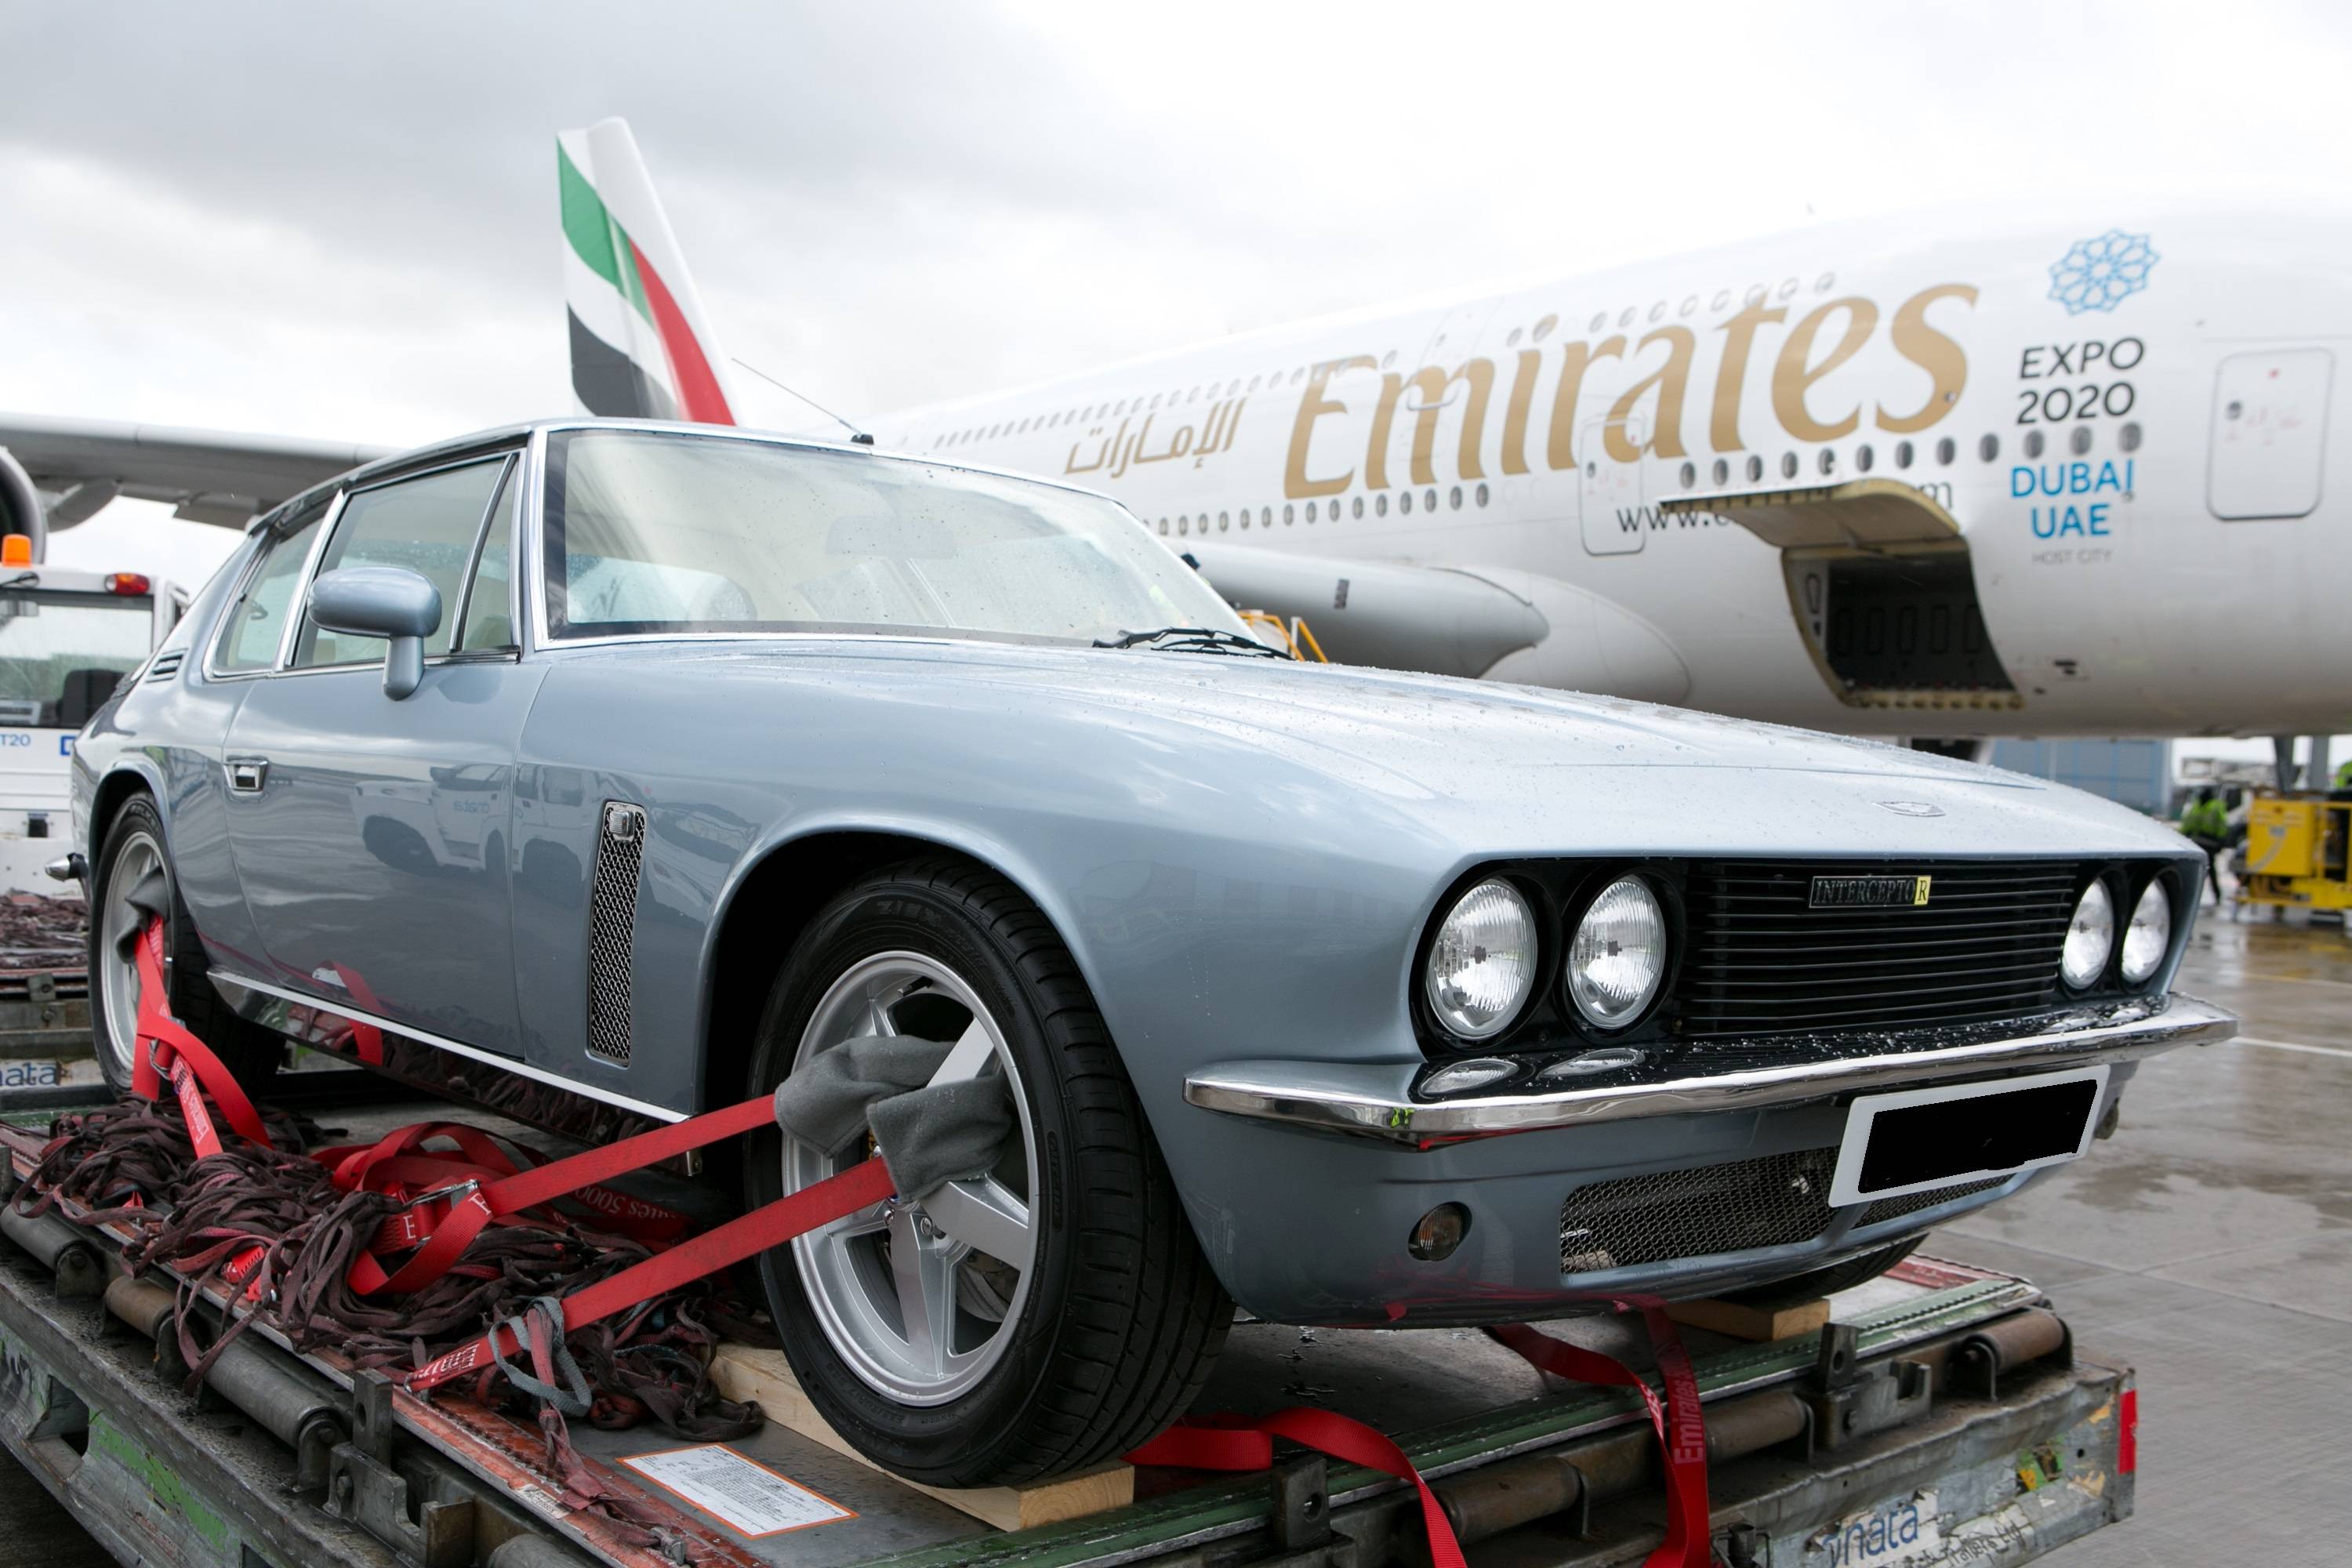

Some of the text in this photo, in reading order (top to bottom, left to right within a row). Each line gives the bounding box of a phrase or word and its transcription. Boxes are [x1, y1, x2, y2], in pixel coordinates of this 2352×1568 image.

[2019, 337, 2146, 379] EXPO
[1283, 283, 1979, 499] Emirates
[2016, 381, 2135, 425] 2020
[1064, 397, 1247, 478] الإمارات
[2010, 459, 2134, 498] DUBAI
[2031, 503, 2112, 539] UAE
[2032, 549, 2112, 565] HOST CITY
[1813, 879, 1928, 903] INTERCEPTOR
[1674, 1380, 1704, 1465] Emirates
